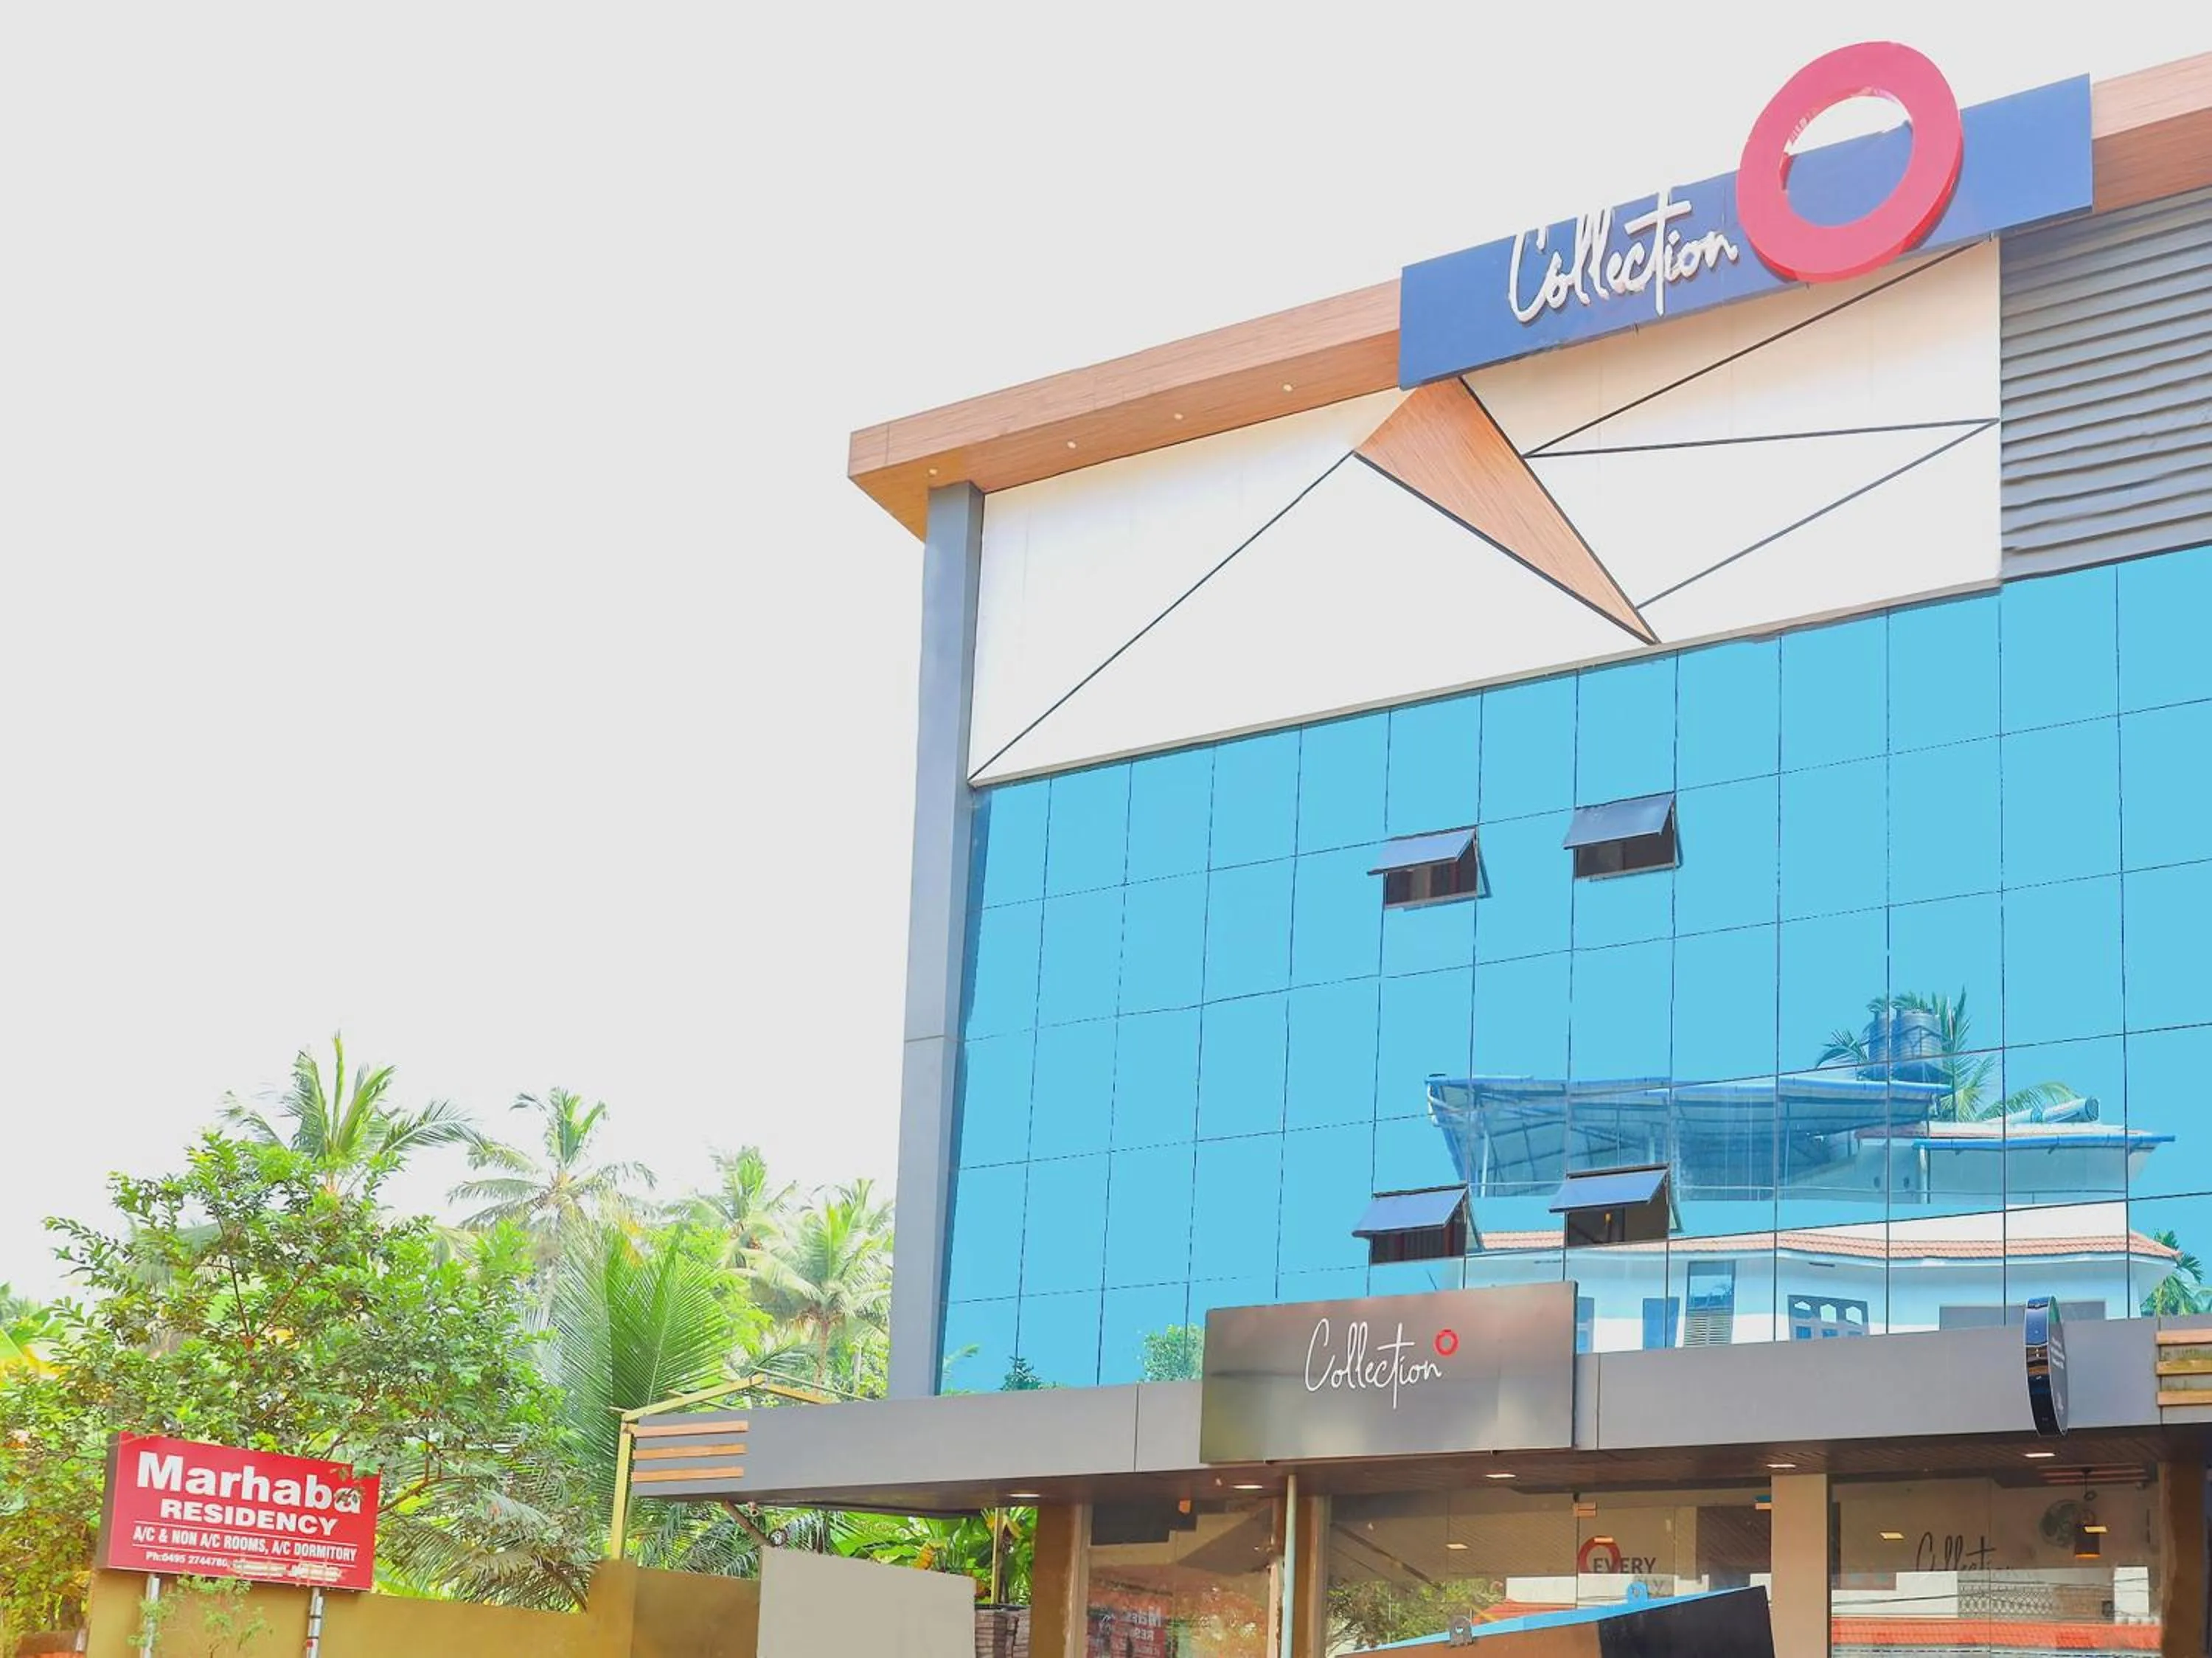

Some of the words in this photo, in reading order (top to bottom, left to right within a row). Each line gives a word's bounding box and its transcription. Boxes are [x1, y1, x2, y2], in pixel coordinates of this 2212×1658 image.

[1508, 189, 1739, 325] Collection
[1304, 1318, 1442, 1409] Collection
[136, 1451, 361, 1514] Marhaba
[161, 1499, 338, 1536] RESIDENCY
[133, 1525, 154, 1544] A/C
[159, 1529, 167, 1543] &
[171, 1530, 197, 1547] NON
[201, 1533, 220, 1550] A/C
[224, 1536, 268, 1555] ROOMS,
[271, 1541, 291, 1556] A/C
[293, 1544, 358, 1562] DORMITORY
[1593, 1556, 1657, 1574] EVERY
